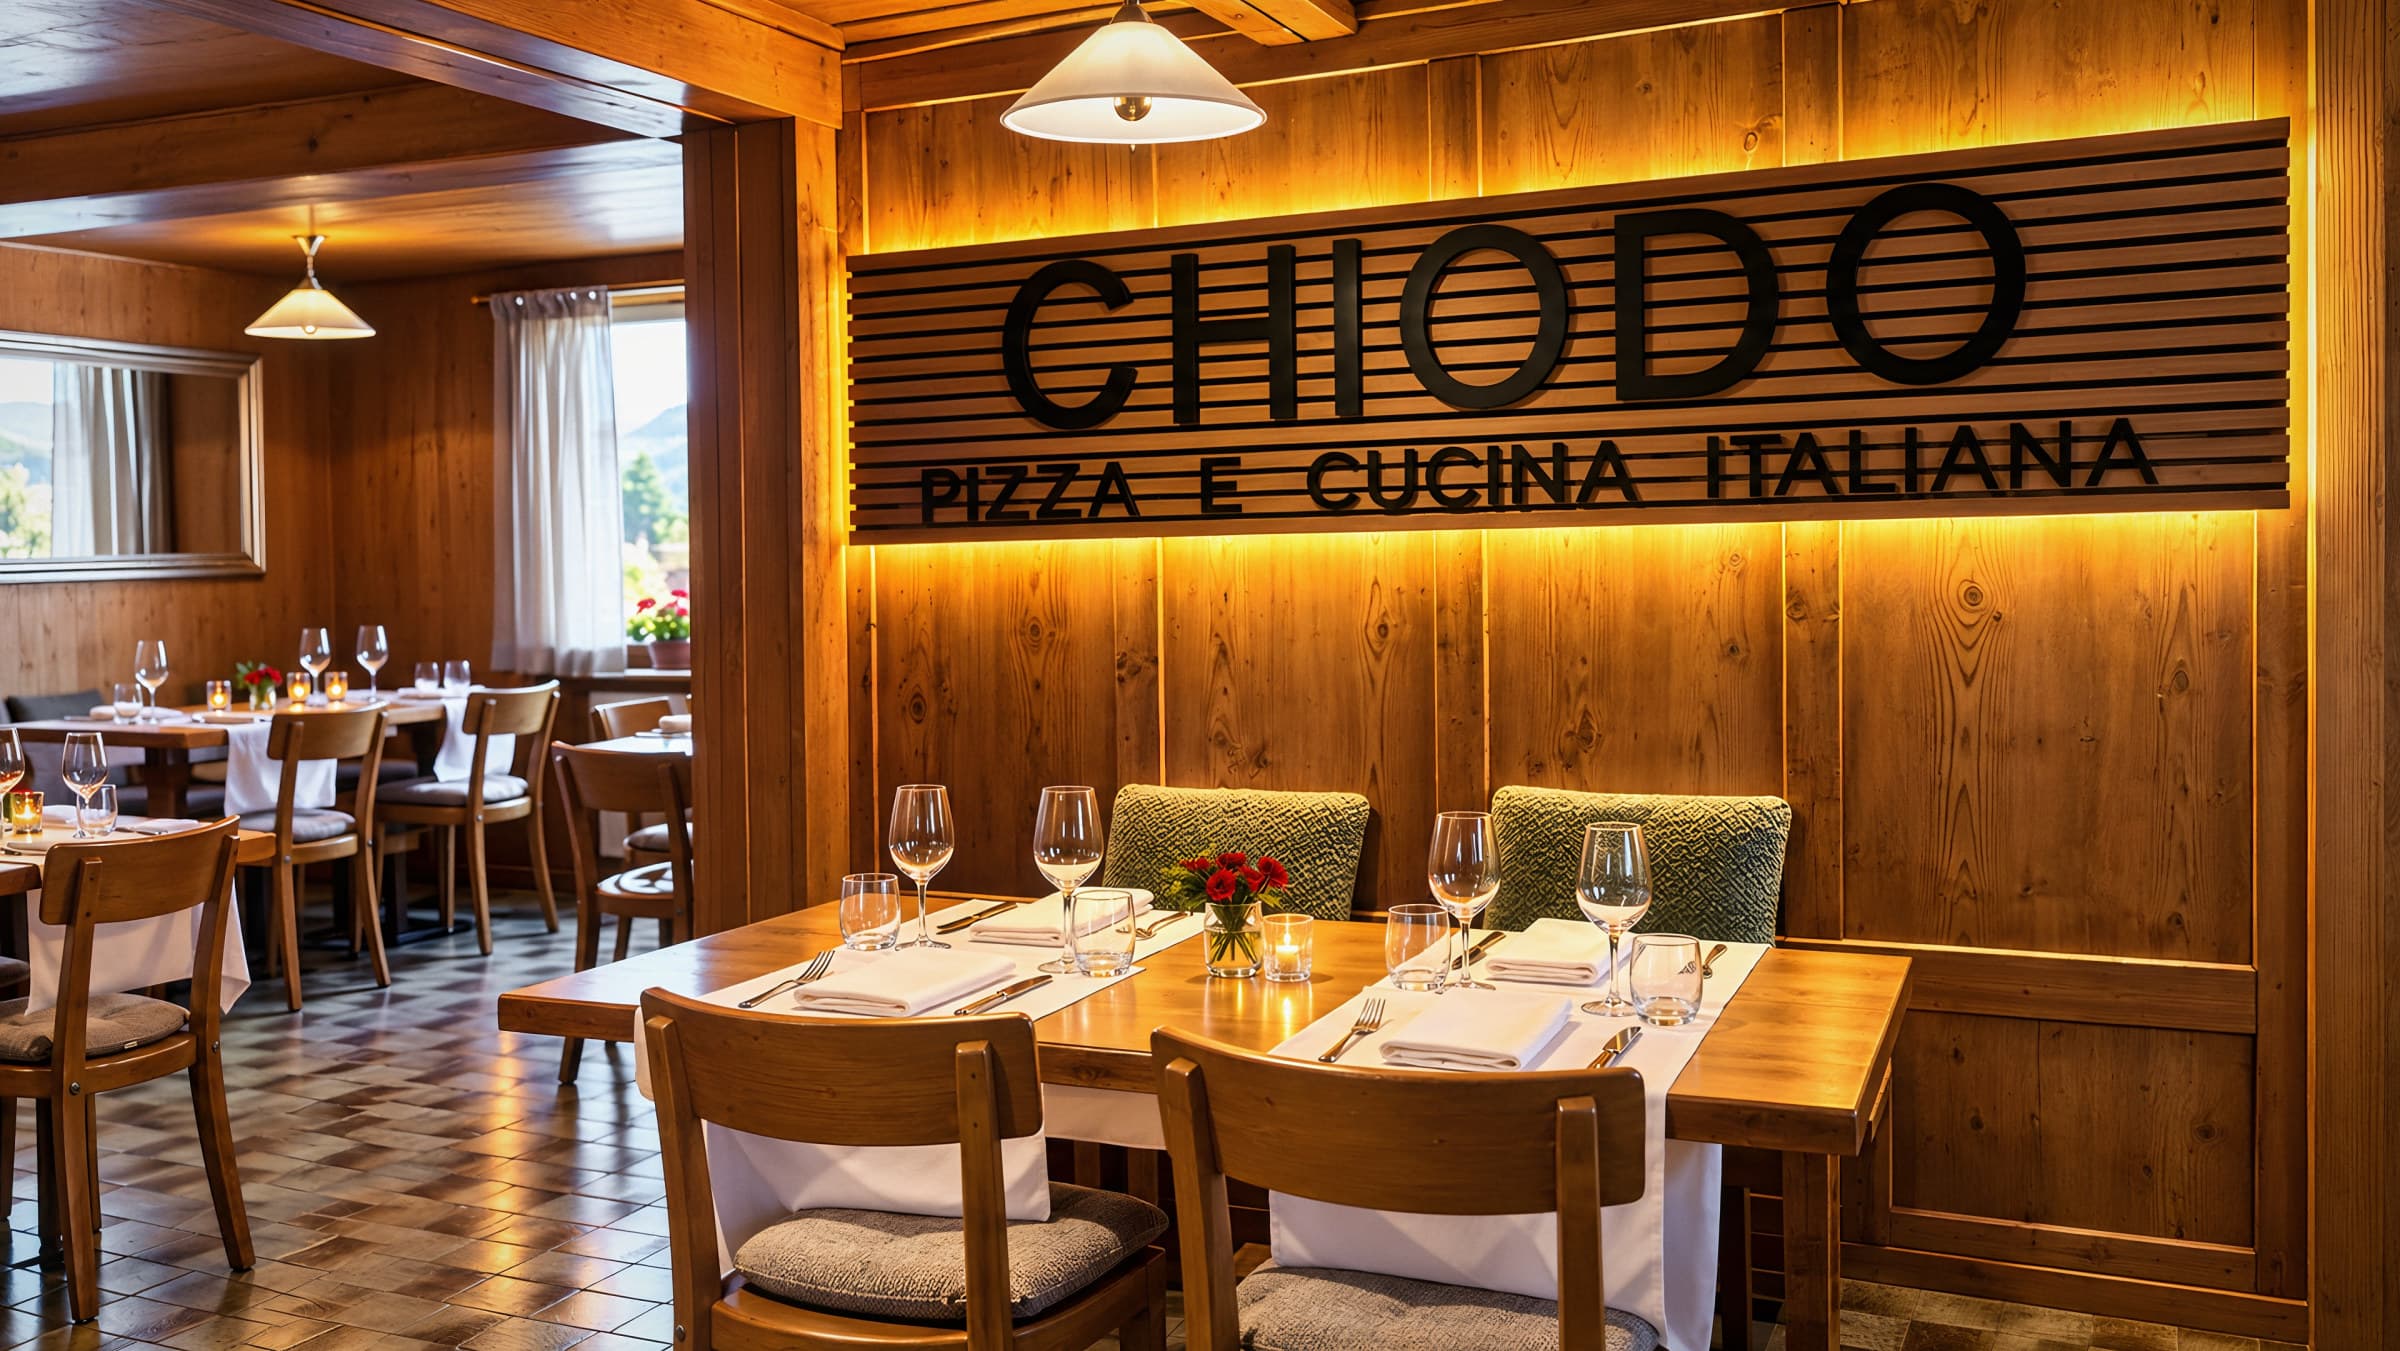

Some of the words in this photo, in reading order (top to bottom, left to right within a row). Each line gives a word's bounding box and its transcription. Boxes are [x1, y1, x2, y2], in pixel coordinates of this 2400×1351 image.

[1002, 183, 2027, 430] CHIODO
[921, 461, 1141, 524] PIZZA
[1201, 456, 1244, 515] E
[1307, 440, 1640, 513] CUCINA
[1707, 418, 2160, 500] ITALIANA
